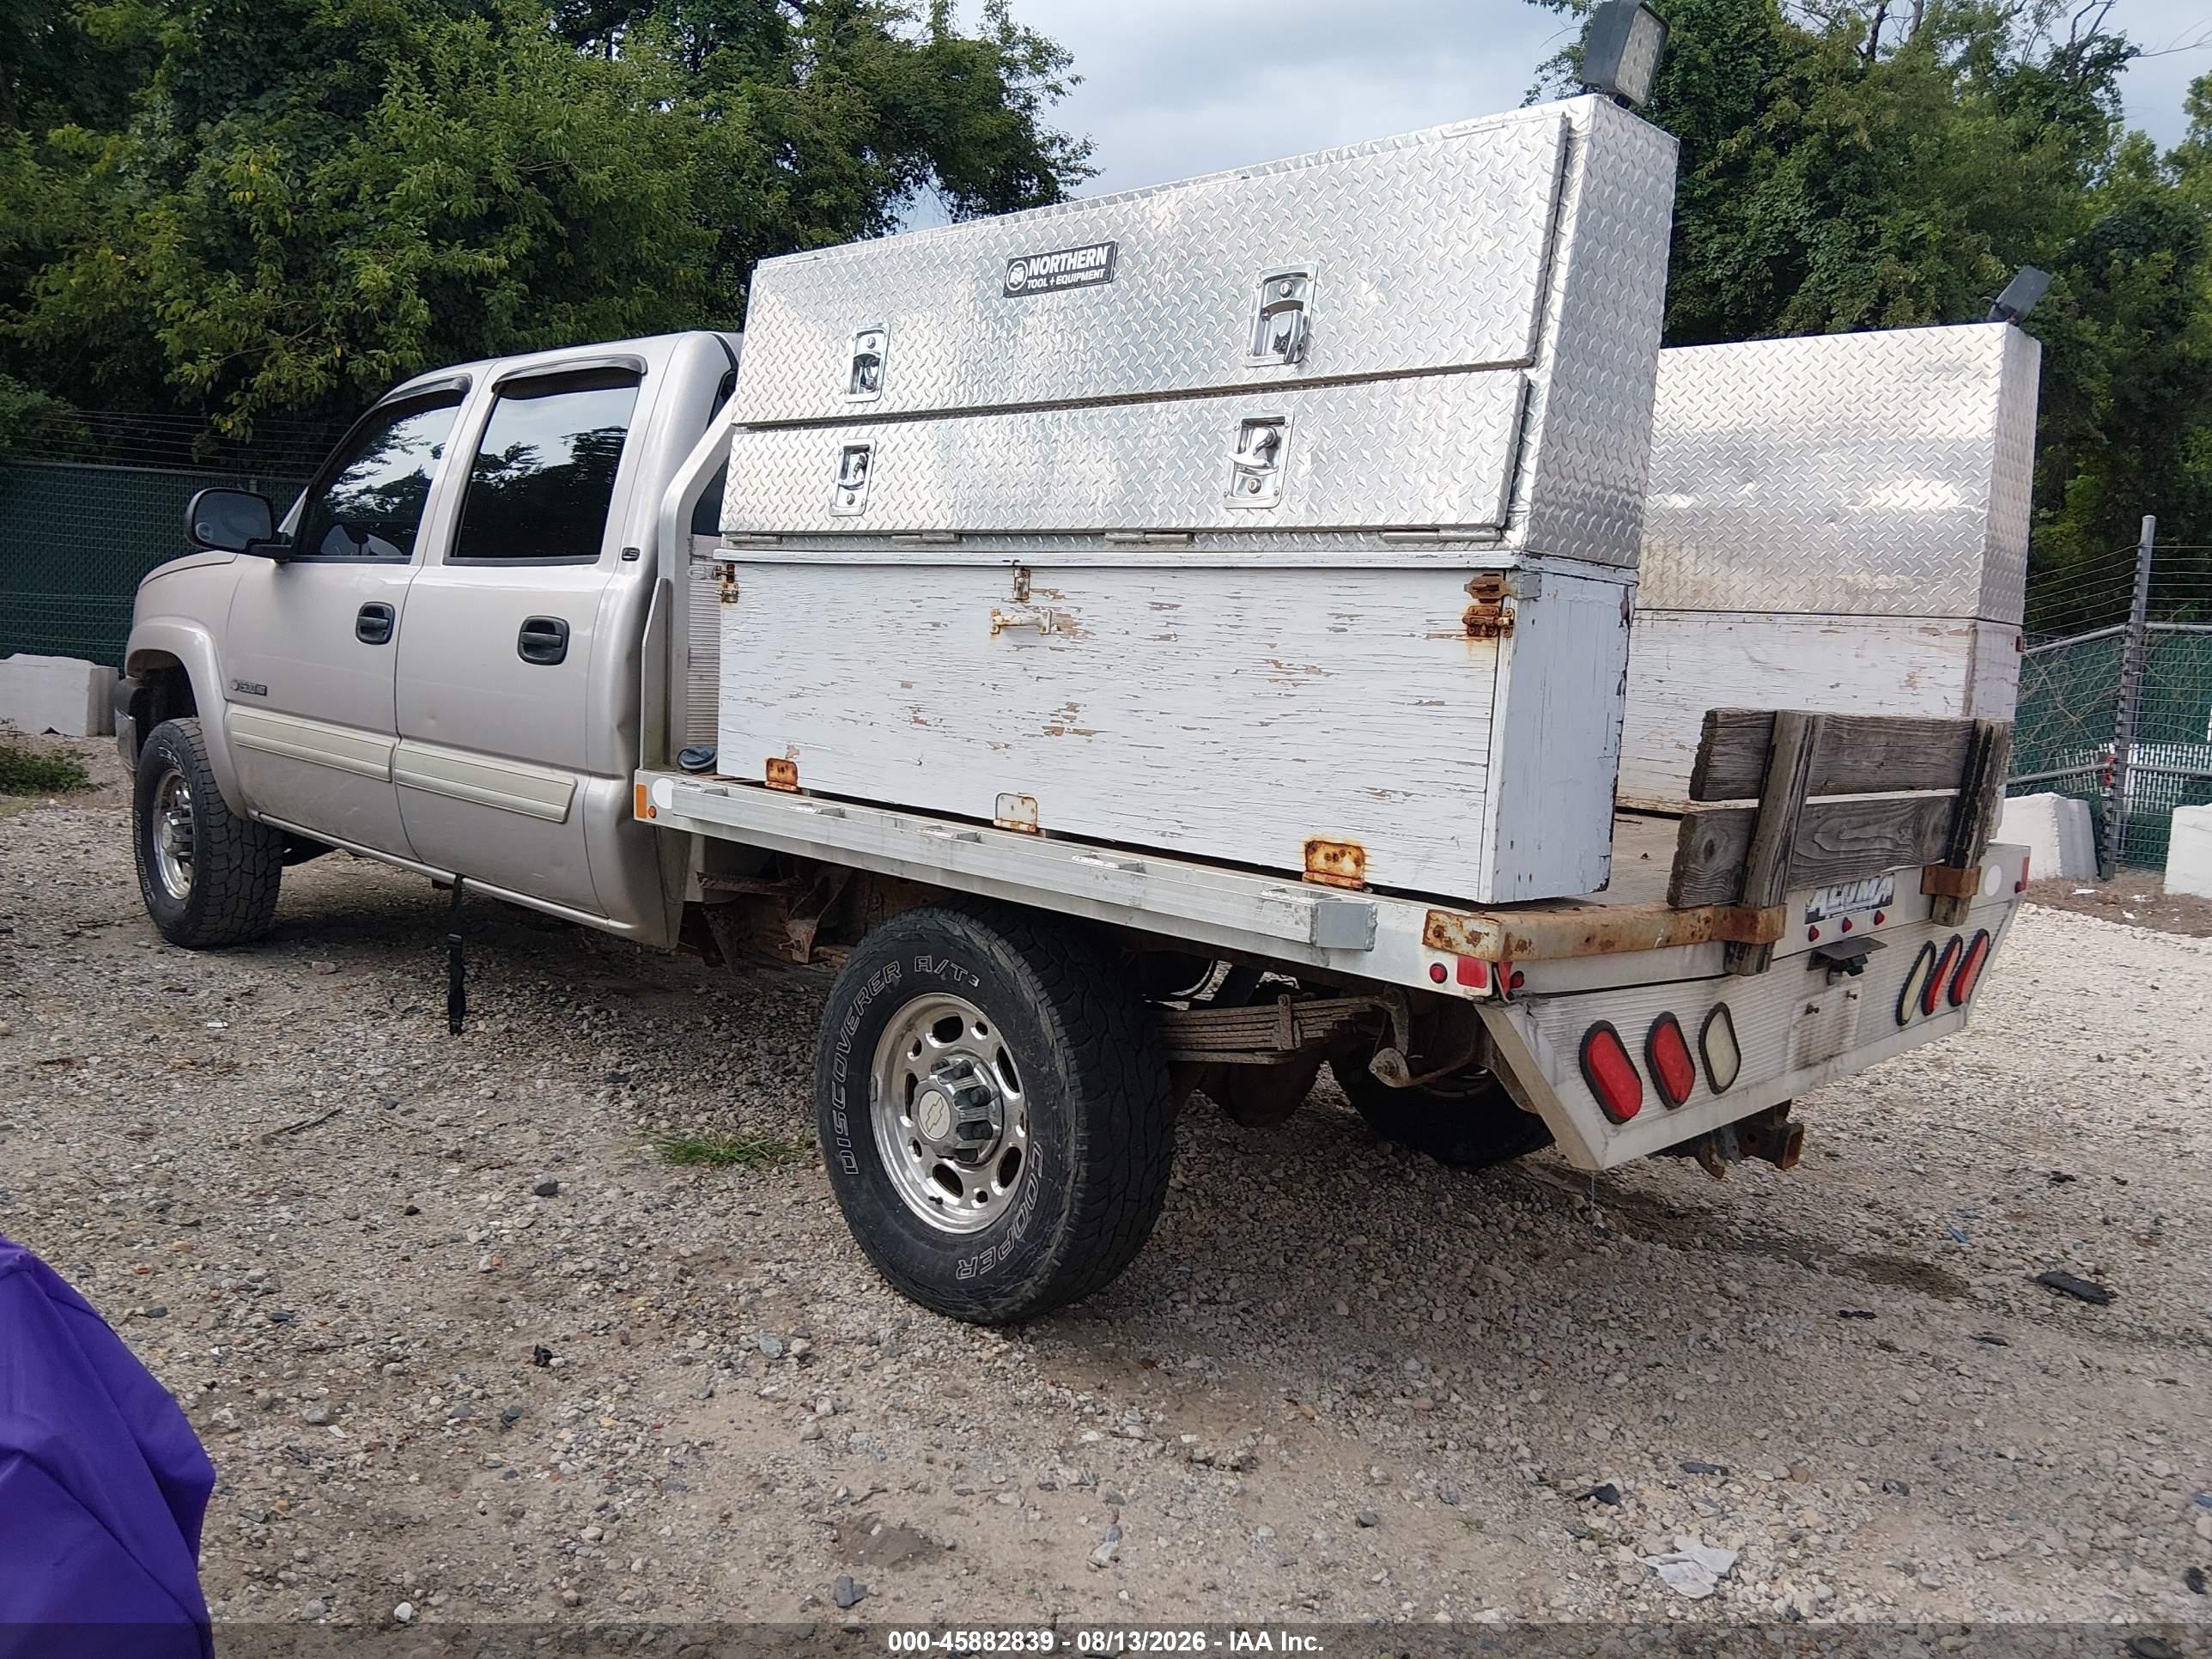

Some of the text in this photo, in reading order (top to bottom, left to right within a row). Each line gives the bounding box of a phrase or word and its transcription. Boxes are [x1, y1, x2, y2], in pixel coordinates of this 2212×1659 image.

[1027, 268, 1106, 289] TOOL + EQUIPMENT
[1028, 245, 1111, 276] NORTHERN
[830, 960, 902, 1176] DISCOVERER
[955, 1141, 1044, 1280] COOPER
